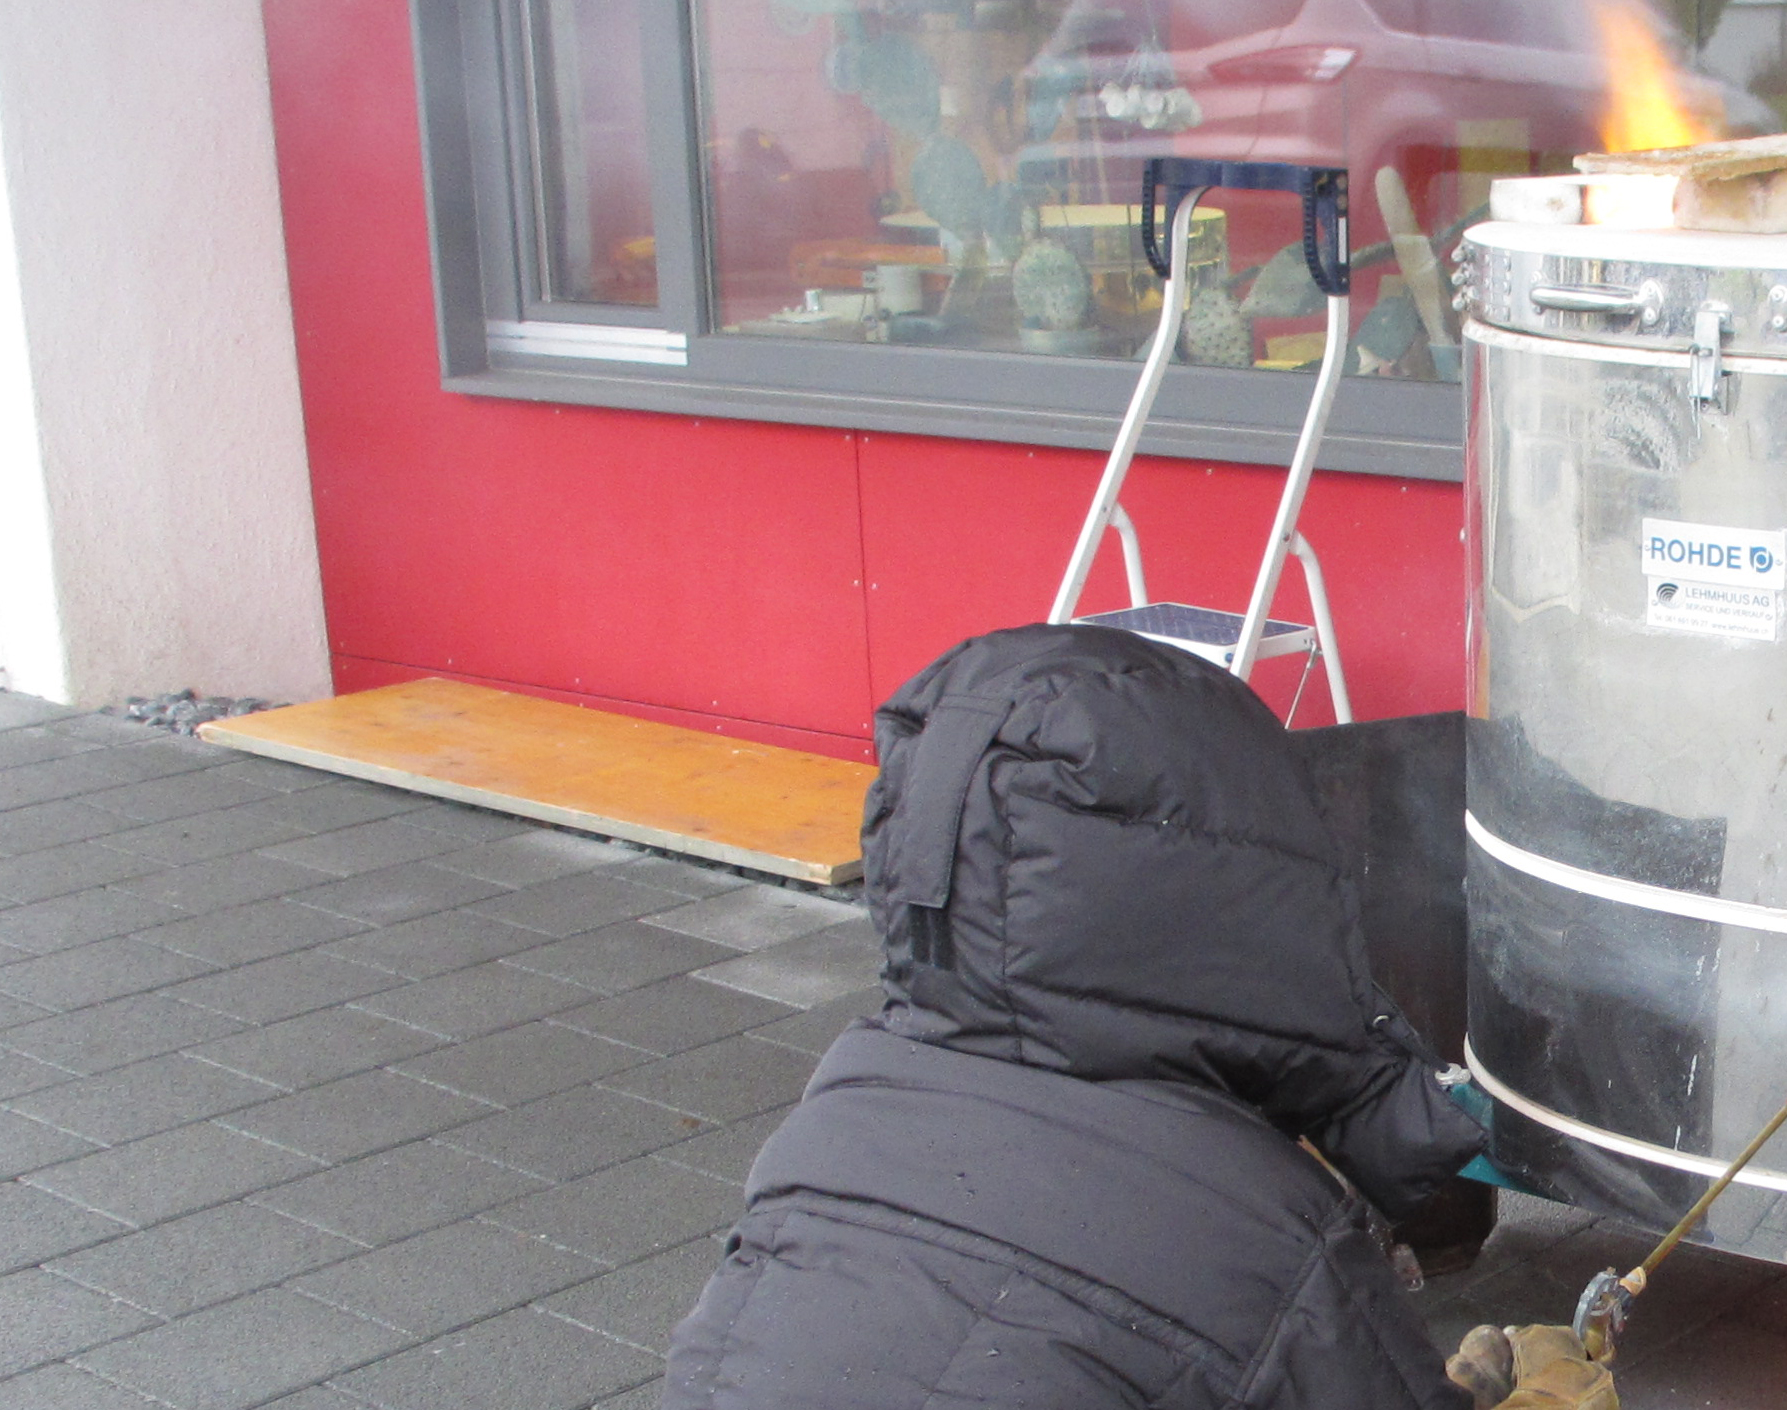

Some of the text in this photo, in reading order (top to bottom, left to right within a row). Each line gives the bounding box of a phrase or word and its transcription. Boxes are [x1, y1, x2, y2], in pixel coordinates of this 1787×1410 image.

[1650, 536, 1742, 570] ROHDE
[1685, 587, 1770, 608] LEHMHUUS AG
